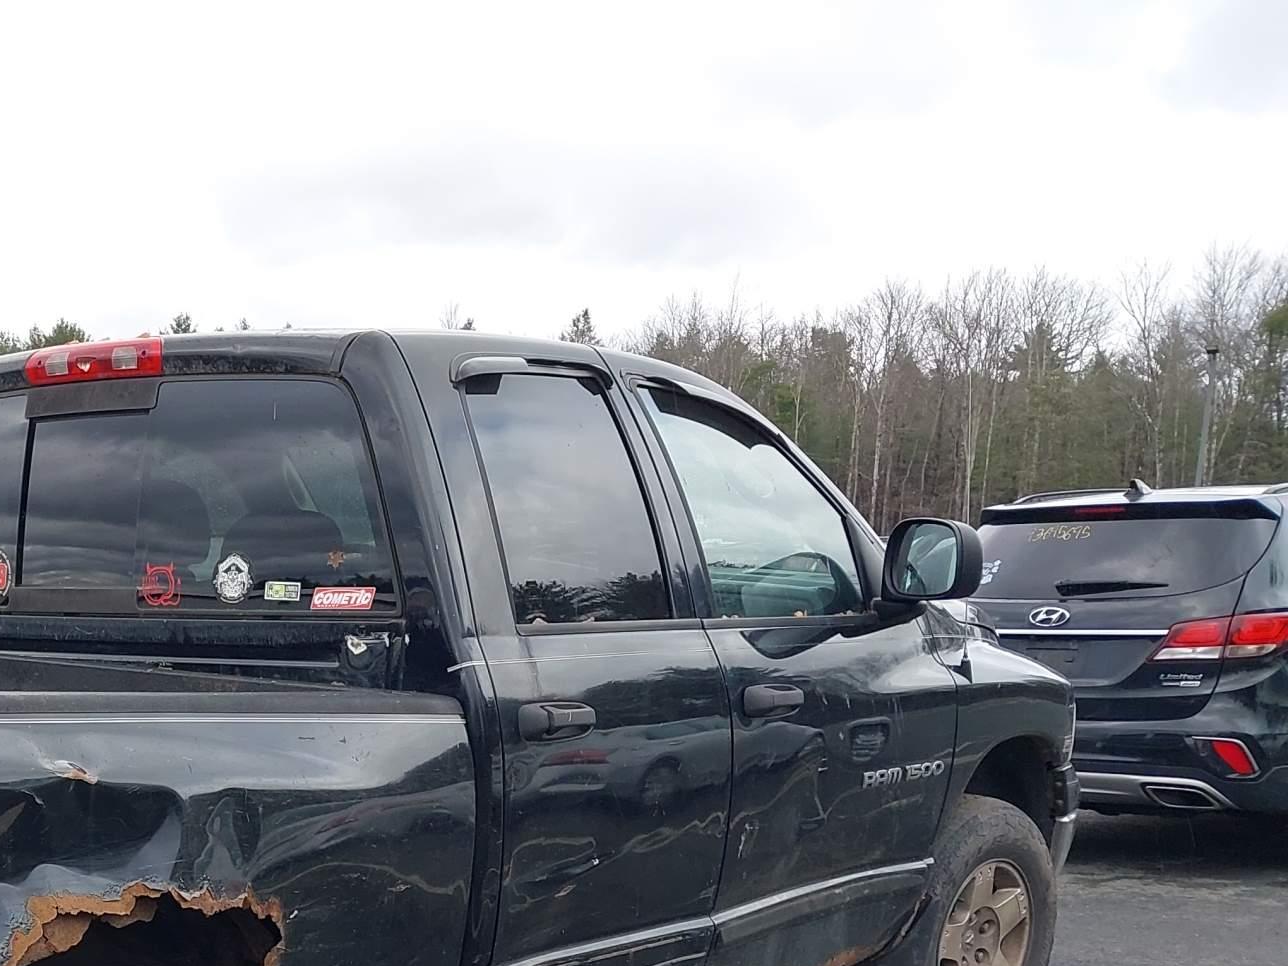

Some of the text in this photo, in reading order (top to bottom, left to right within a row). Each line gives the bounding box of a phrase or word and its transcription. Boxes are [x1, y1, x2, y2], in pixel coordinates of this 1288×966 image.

[314, 589, 371, 605] COMETIC
[862, 760, 945, 789] RAM 1500
